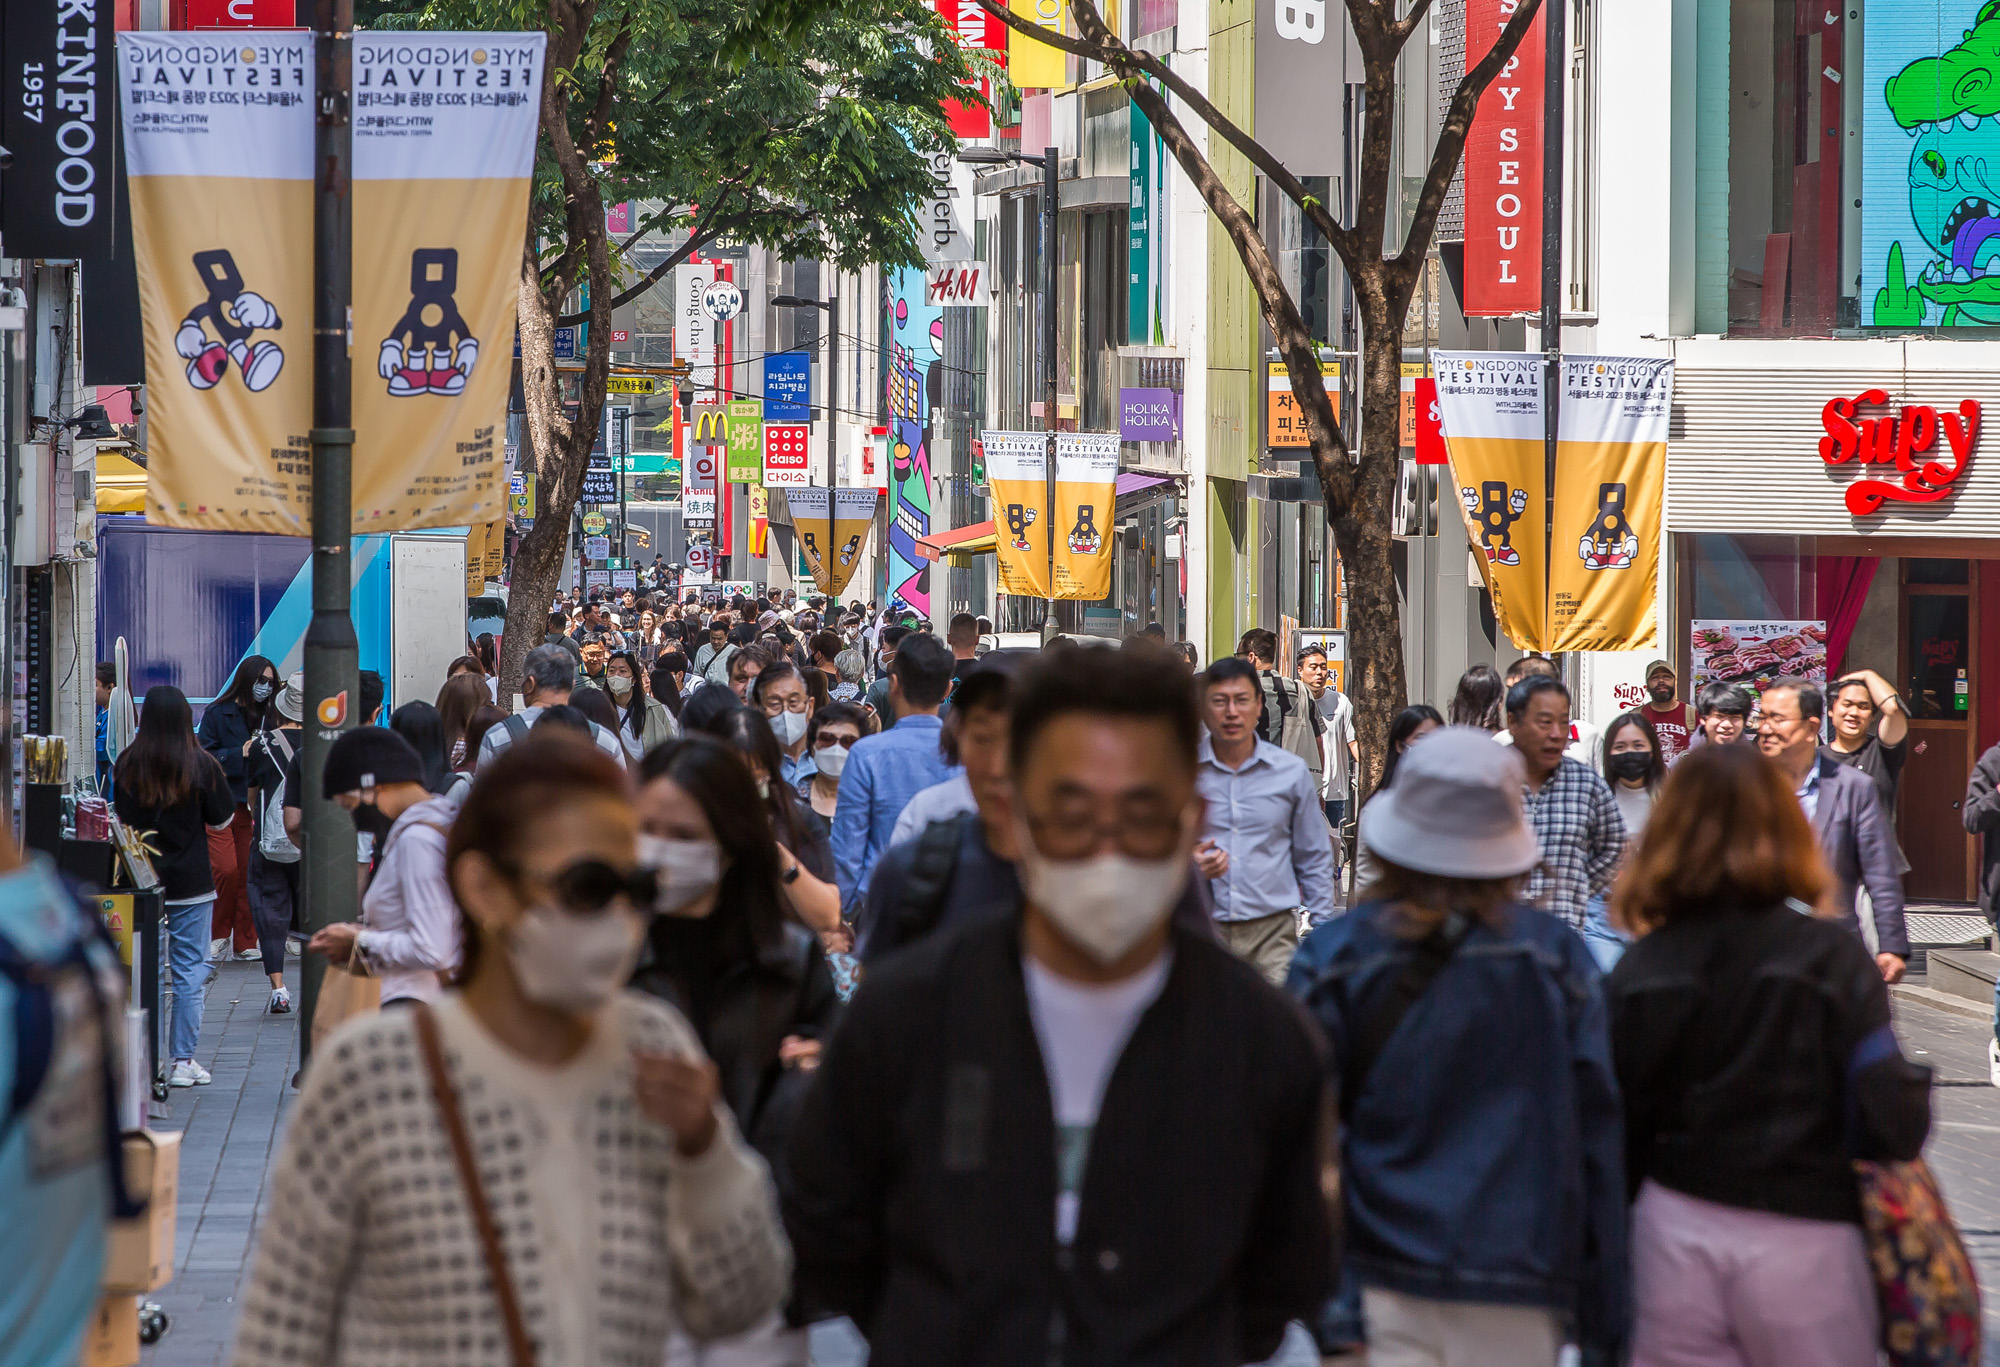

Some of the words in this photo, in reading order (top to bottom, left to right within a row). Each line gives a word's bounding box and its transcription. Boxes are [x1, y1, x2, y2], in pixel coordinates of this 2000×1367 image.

[957, 0, 986, 48] KIN
[23, 62, 44, 124] 1957
[1496, 128, 1522, 284] SEOUL
[930, 268, 980, 302] H&M
[686, 277, 704, 316] Gong
[613, 332, 626, 341] 5G
[690, 320, 704, 346] cha
[1437, 359, 1538, 372] MYEONGDONG
[1568, 363, 1668, 376] MYEONGDONG
[768, 372, 806, 382] 라임나무
[1439, 372, 1538, 385] FESTIVAL
[1568, 375, 1667, 389] FESTIVAL
[623, 381, 645, 391] 작동중
[768, 382, 807, 392] 치과병원
[1441, 386, 1475, 395] 서울페스타
[1476, 387, 1494, 395] 2023
[1495, 387, 1509, 396] 명동
[1510, 387, 1538, 397] 페스티벌
[781, 393, 794, 402] 7F
[1568, 389, 1604, 399] 서울페스타
[1605, 391, 1623, 399] 2023
[1625, 391, 1638, 400] 명동
[1125, 403, 1170, 415] HOLIKA
[1125, 415, 1170, 426] HOLIKA
[1277, 417, 1307, 434] 피부
[731, 422, 759, 451] 粥
[984, 435, 1044, 443] MYEONGDONG
[1060, 438, 1118, 446] MYEONGDONG
[1060, 445, 1117, 453] FESTIVAL
[1818, 388, 1982, 516] Supy
[770, 453, 804, 465] daiso
[767, 472, 806, 482] 다이소
[684, 486, 716, 496] K-GRIL
[688, 519, 713, 528] 明洞店
[689, 549, 712, 570] 약
[1613, 682, 1648, 710] Supy
